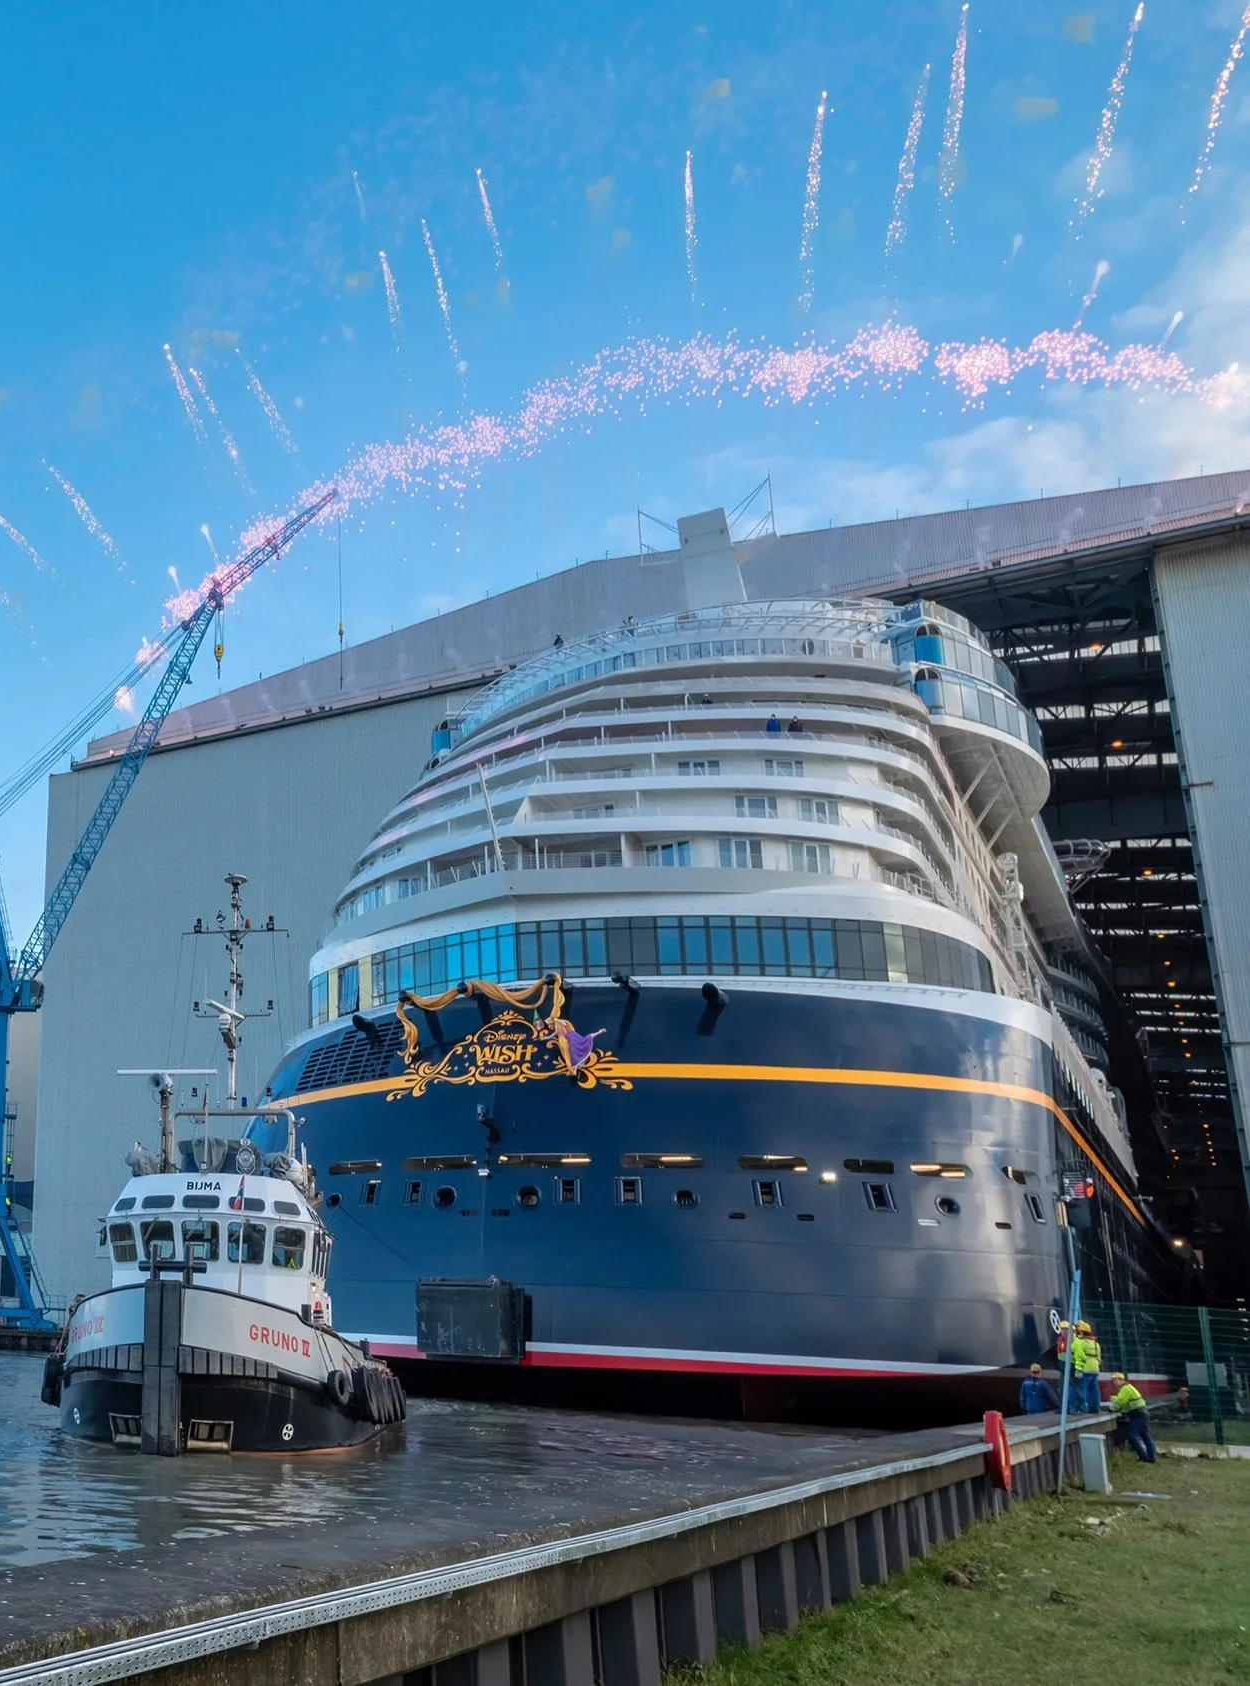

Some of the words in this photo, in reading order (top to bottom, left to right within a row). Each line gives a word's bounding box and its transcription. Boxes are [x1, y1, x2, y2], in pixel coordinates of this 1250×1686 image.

[468, 1044, 538, 1066] WISH
[485, 1067, 510, 1075] NASSAU
[186, 1181, 222, 1191] BIJMA
[249, 1323, 299, 1353] GRUNO
